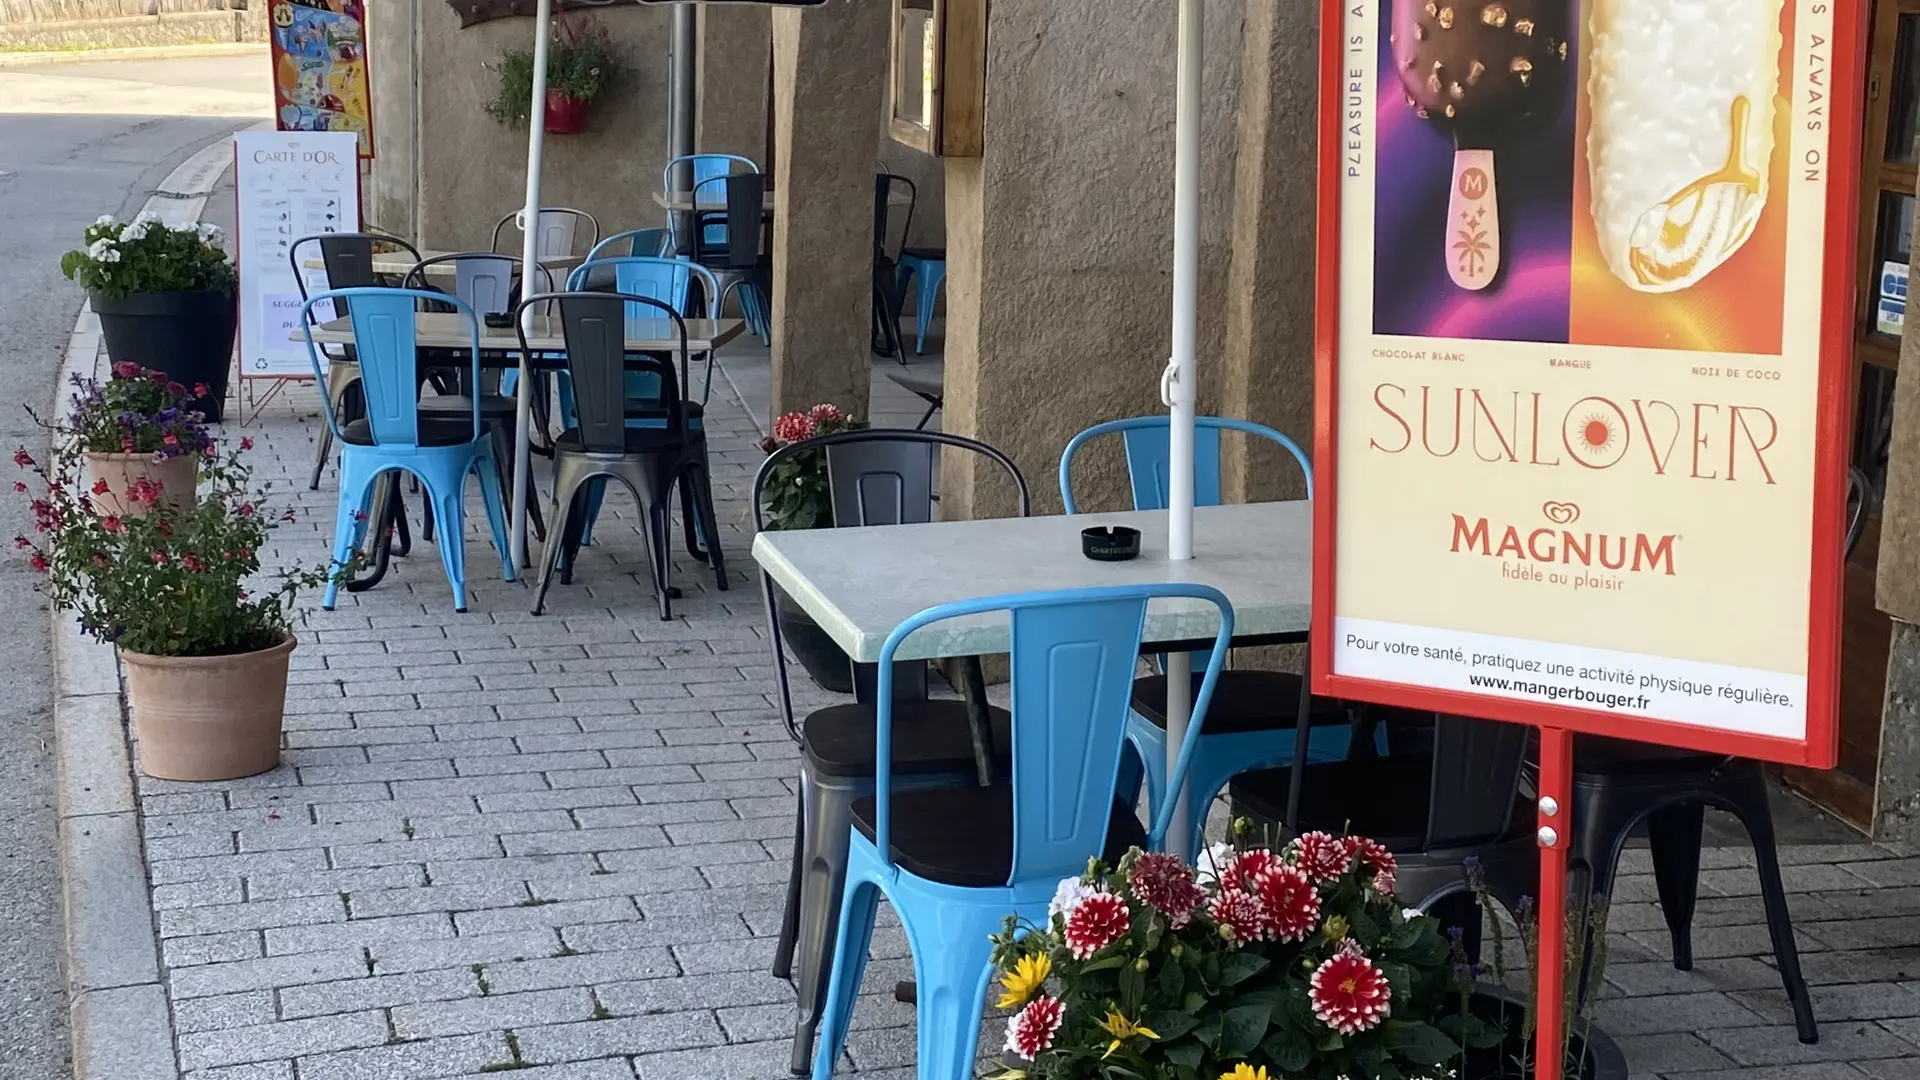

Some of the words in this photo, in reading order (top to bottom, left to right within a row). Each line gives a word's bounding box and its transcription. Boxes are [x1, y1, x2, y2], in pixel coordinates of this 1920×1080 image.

[1350, 35, 1363, 52] IS
[1807, 34, 1825, 131] ALWAYS
[1347, 68, 1363, 177] PLEASURE
[253, 150, 297, 164] CARTE
[303, 150, 341, 164] D'OR
[1805, 149, 1820, 182] ON
[1464, 173, 1482, 193] M
[271, 300, 331, 309] SUGGEION
[1371, 348, 1427, 360] CHOCOLAT
[1432, 351, 1466, 362] BLANC
[1549, 358, 1592, 369] MANGUE
[1691, 366, 1720, 377] NOIX
[1726, 368, 1740, 378] DE
[1746, 369, 1781, 381] COCO
[1370, 382, 1778, 485] SUNLOVER
[1450, 512, 1677, 576] MAGNUM
[1501, 561, 1543, 582] fidèle
[1549, 573, 1568, 585] au
[1574, 570, 1624, 590] plaisir
[1346, 633, 1379, 650] Pour
[1384, 641, 1419, 656] votre
[1423, 646, 1467, 665] santé,
[1472, 652, 1542, 673] pratiquez
[1546, 662, 1574, 677] une
[1579, 664, 1635, 685] activité
[1639, 674, 1713, 697] physique
[1717, 683, 1794, 708] régulière.
[1469, 673, 1651, 710] www.mangerbouger.fr
